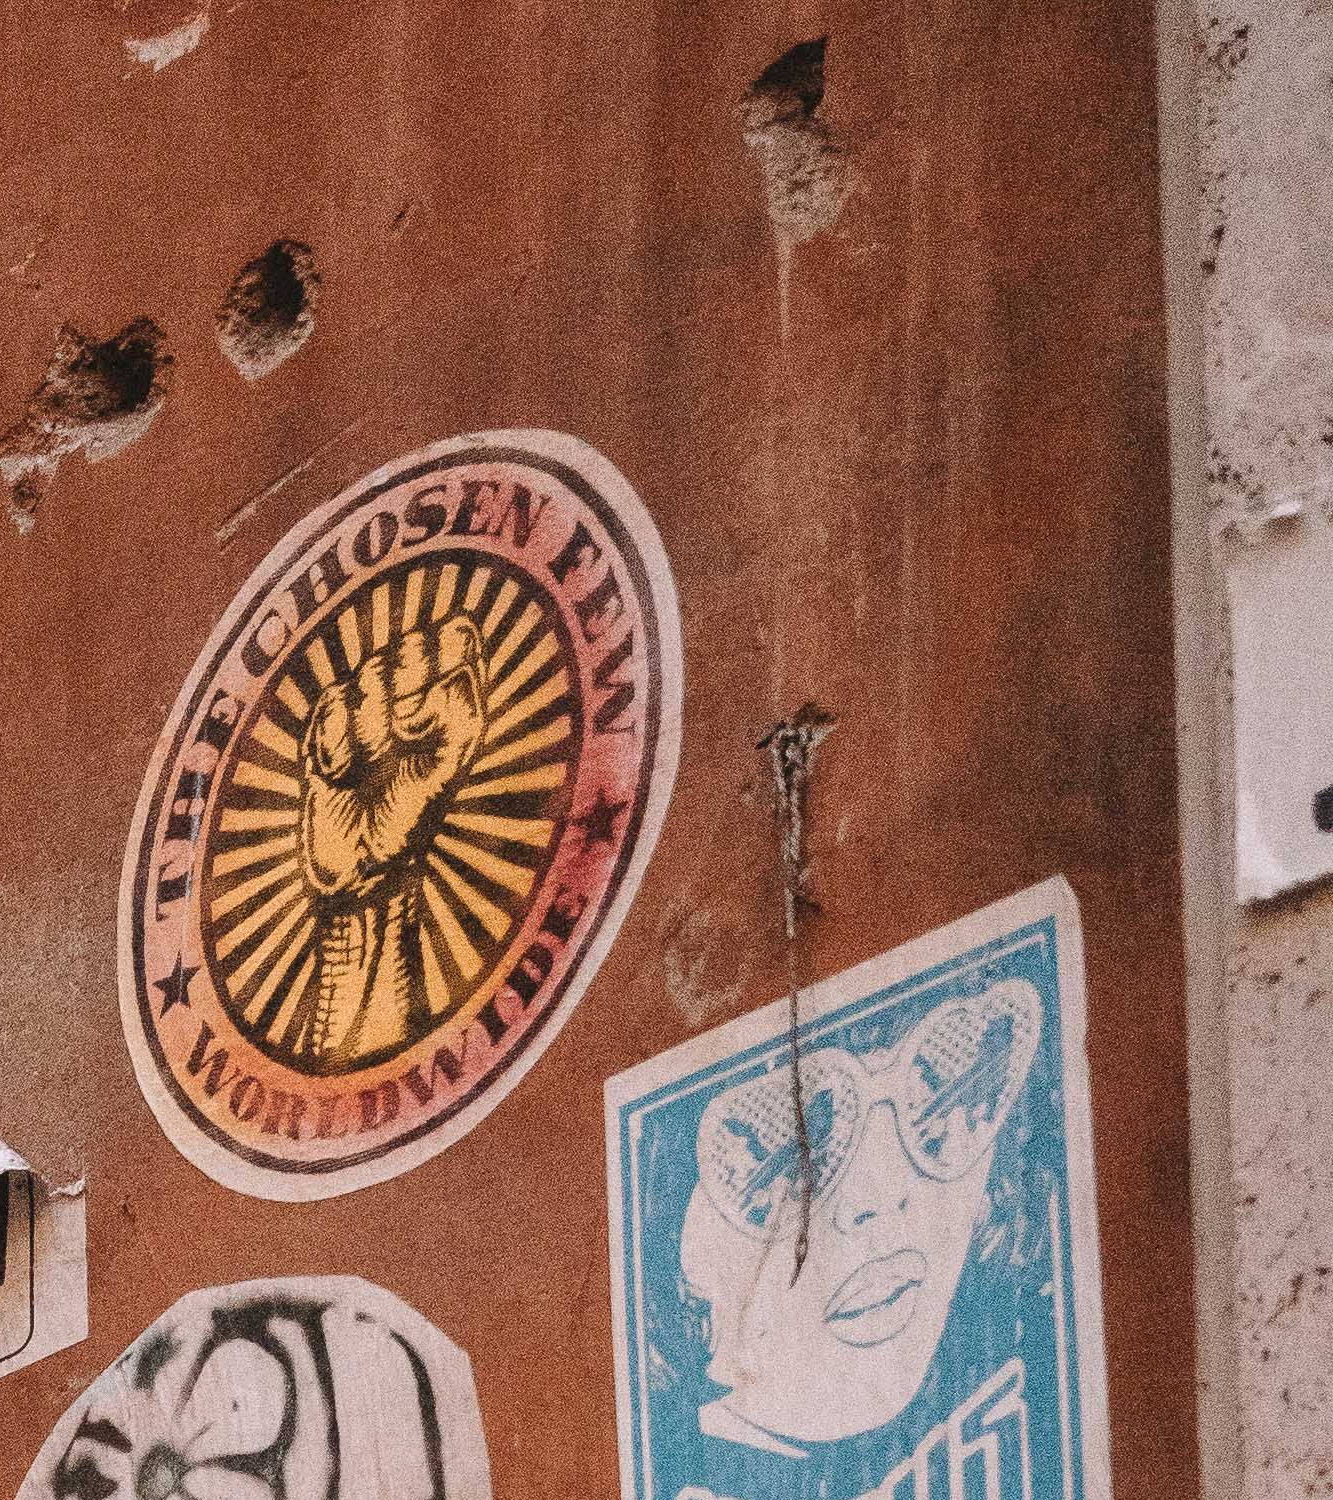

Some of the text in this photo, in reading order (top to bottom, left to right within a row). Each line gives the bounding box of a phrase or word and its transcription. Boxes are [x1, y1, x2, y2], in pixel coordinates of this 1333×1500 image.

[154, 477, 642, 922] THE CHOSEN FEW
[183, 887, 590, 1141] WORLDWIDE
